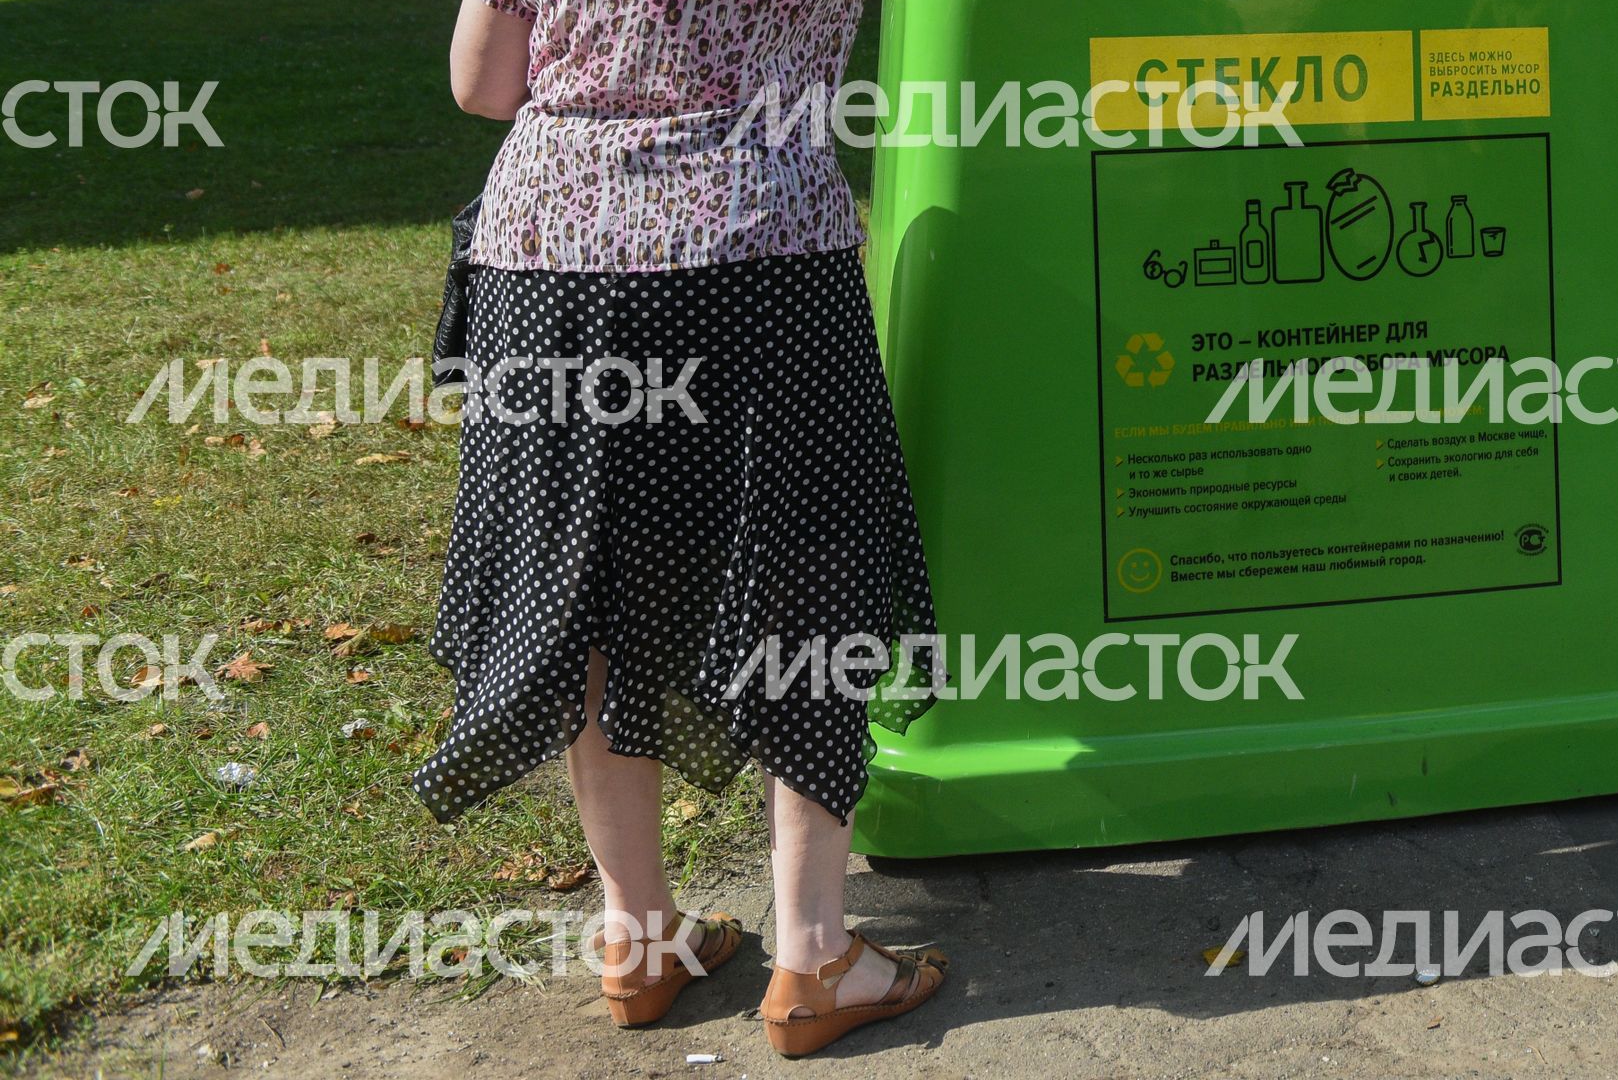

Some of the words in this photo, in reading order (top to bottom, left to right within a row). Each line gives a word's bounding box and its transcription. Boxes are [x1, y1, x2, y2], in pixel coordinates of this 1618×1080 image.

[1429, 52, 1465, 64] ЗДЕСЬ
[1470, 51, 1512, 61] МОЖНО
[1430, 65, 1497, 76] ВЫБРОСИТЬ
[1502, 63, 1539, 75] МУСОР
[1136, 53, 1368, 108] СТЕКЛО
[1430, 79, 1540, 99] РАЗДЕЛЬНО
[1191, 332, 1233, 352] ЭТО
[1257, 322, 1380, 349] КОНТЕЙНЕР
[1386, 321, 1428, 343] ДЛЯ
[1193, 356, 1347, 382] РАЗДЕЛЬНОГО
[1353, 351, 1421, 373] СБОРА
[1427, 345, 1510, 367] МУСОРА
[1115, 428, 1146, 438] ЕСЛИ
[1149, 426, 1168, 436] МЫ
[1173, 423, 1211, 435] БУДЕМ
[1387, 437, 1429, 450] Сделать
[1432, 434, 1467, 448] воздух
[1469, 435, 1476, 444] в
[1478, 430, 1516, 442] Москве
[1518, 428, 1548, 440] чище,
[1127, 452, 1186, 465] Несколько
[1189, 451, 1207, 463] раз
[1210, 447, 1284, 461] использовать
[1286, 445, 1312, 456] одно
[1387, 456, 1441, 470] Сохранить
[1444, 451, 1492, 464] экологию
[1495, 450, 1513, 461] для
[1516, 446, 1539, 458] себя
[1129, 471, 1136, 480] и
[1139, 470, 1150, 479] то
[1152, 468, 1168, 478] же
[1170, 466, 1204, 480] сырье
[1389, 474, 1396, 483] и
[1398, 472, 1428, 482] своих
[1430, 467, 1462, 480] детей.
[1128, 486, 1187, 499] Экономить
[1190, 481, 1251, 496] природные
[1253, 479, 1297, 492] ресурсы
[1128, 505, 1181, 519] Улучшить
[1184, 502, 1238, 514] состояние
[1241, 495, 1311, 512] окружающей
[1314, 493, 1346, 507] среды
[1170, 554, 1225, 567] Спасибо,
[1228, 551, 1248, 562] что
[1251, 546, 1325, 562] пользуетесь
[1327, 539, 1411, 556] контейнерами
[1414, 538, 1428, 549] по
[1430, 530, 1505, 548] назначению!
[1171, 571, 1214, 583] Вместе
[1217, 570, 1236, 580] мы
[1239, 565, 1298, 580] сбережем
[1301, 563, 1326, 573] наш
[1329, 555, 1386, 571] любимый
[1389, 556, 1427, 568] город.
